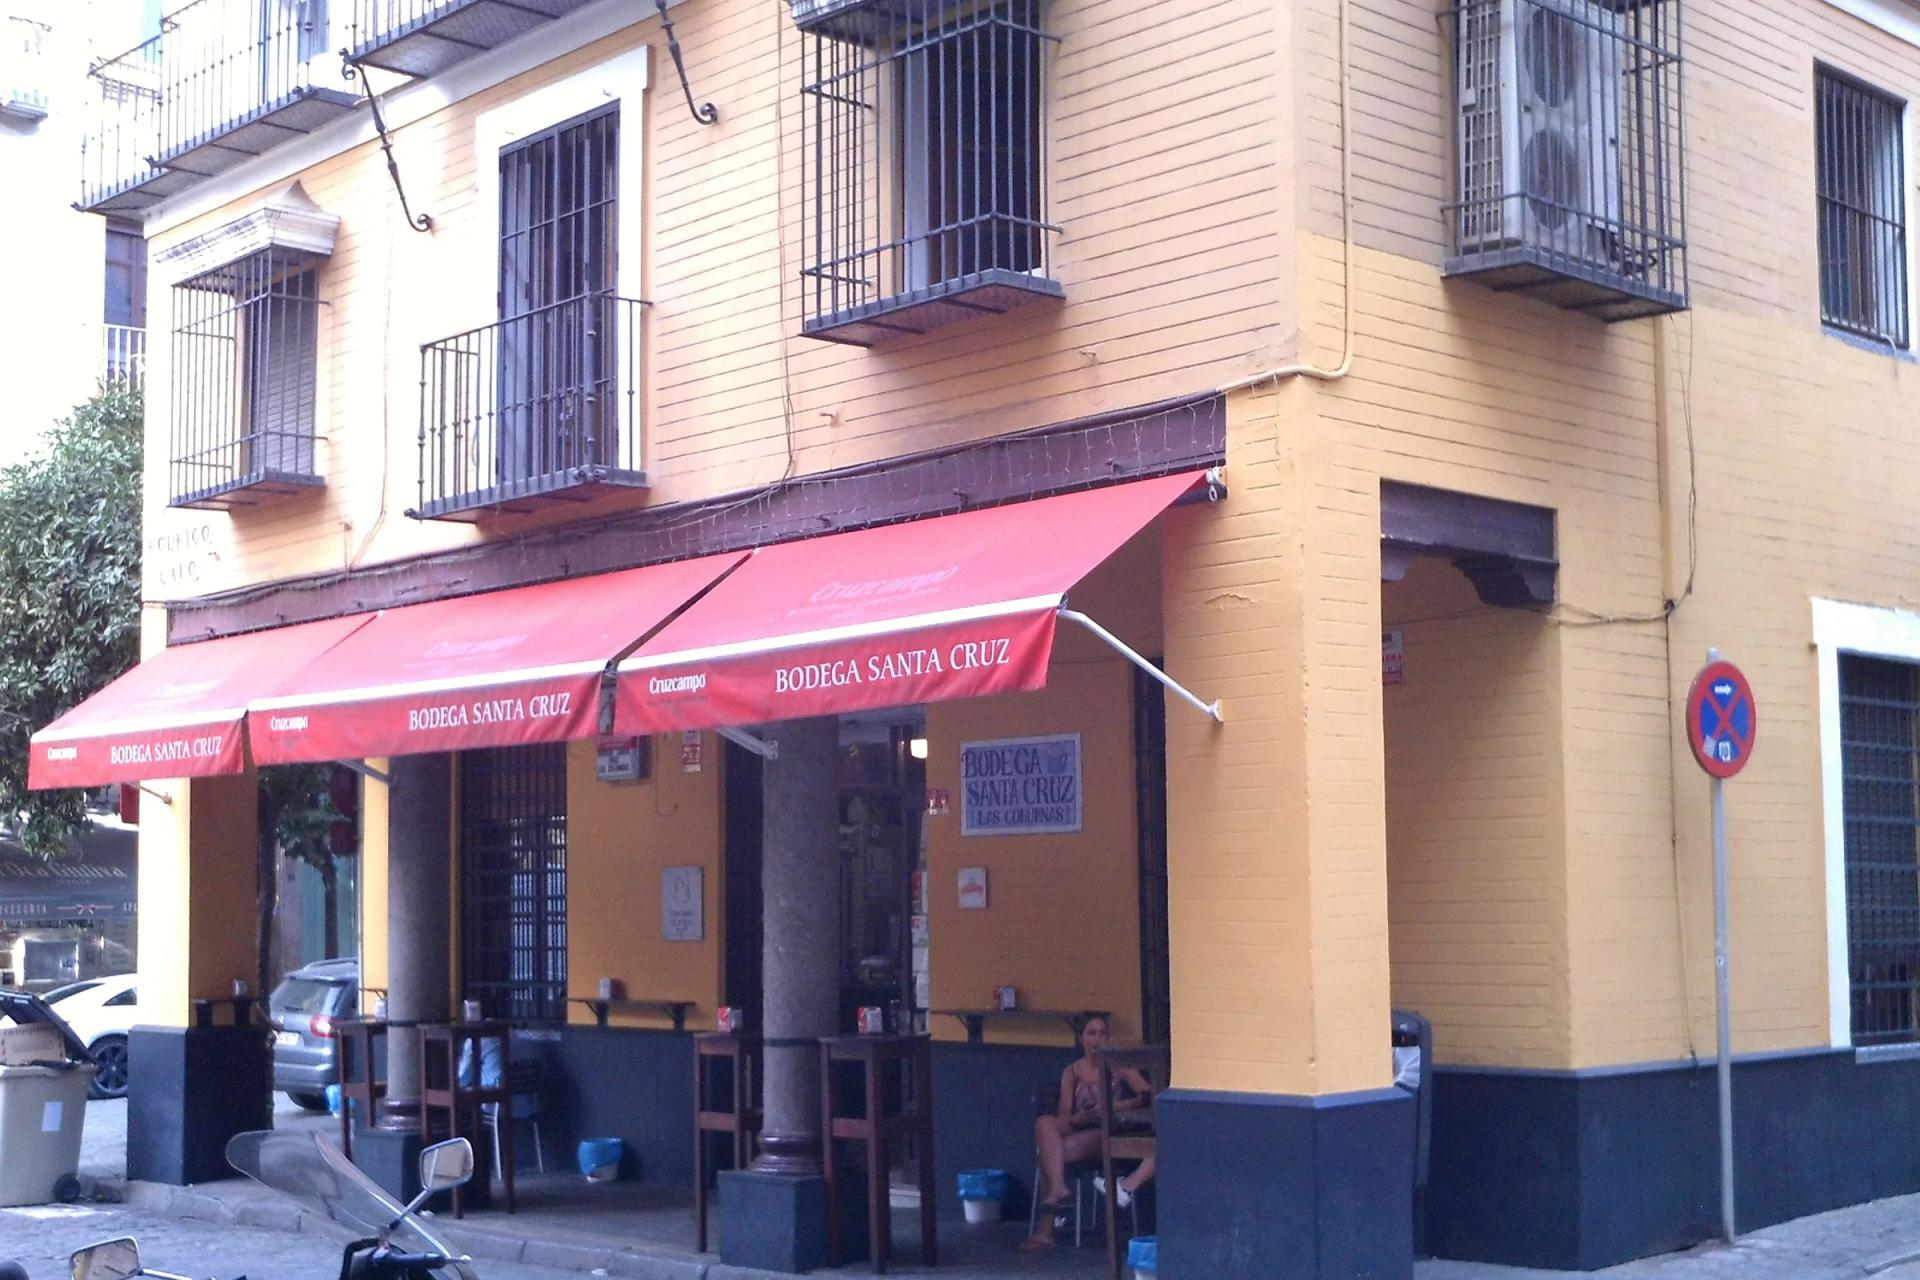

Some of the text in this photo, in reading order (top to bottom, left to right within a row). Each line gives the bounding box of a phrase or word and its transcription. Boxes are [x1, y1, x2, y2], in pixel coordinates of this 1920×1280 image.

[775, 638, 1011, 693] BODEGA SANTA CRUZ
[648, 672, 707, 695] Cruzcampo
[408, 692, 571, 732] BODEGA SANTA CRUZ
[110, 735, 222, 765] BODEGA SANTA CRUZ
[962, 748, 1042, 779] BODEGA
[967, 775, 1075, 808] SANTA CRUZ
